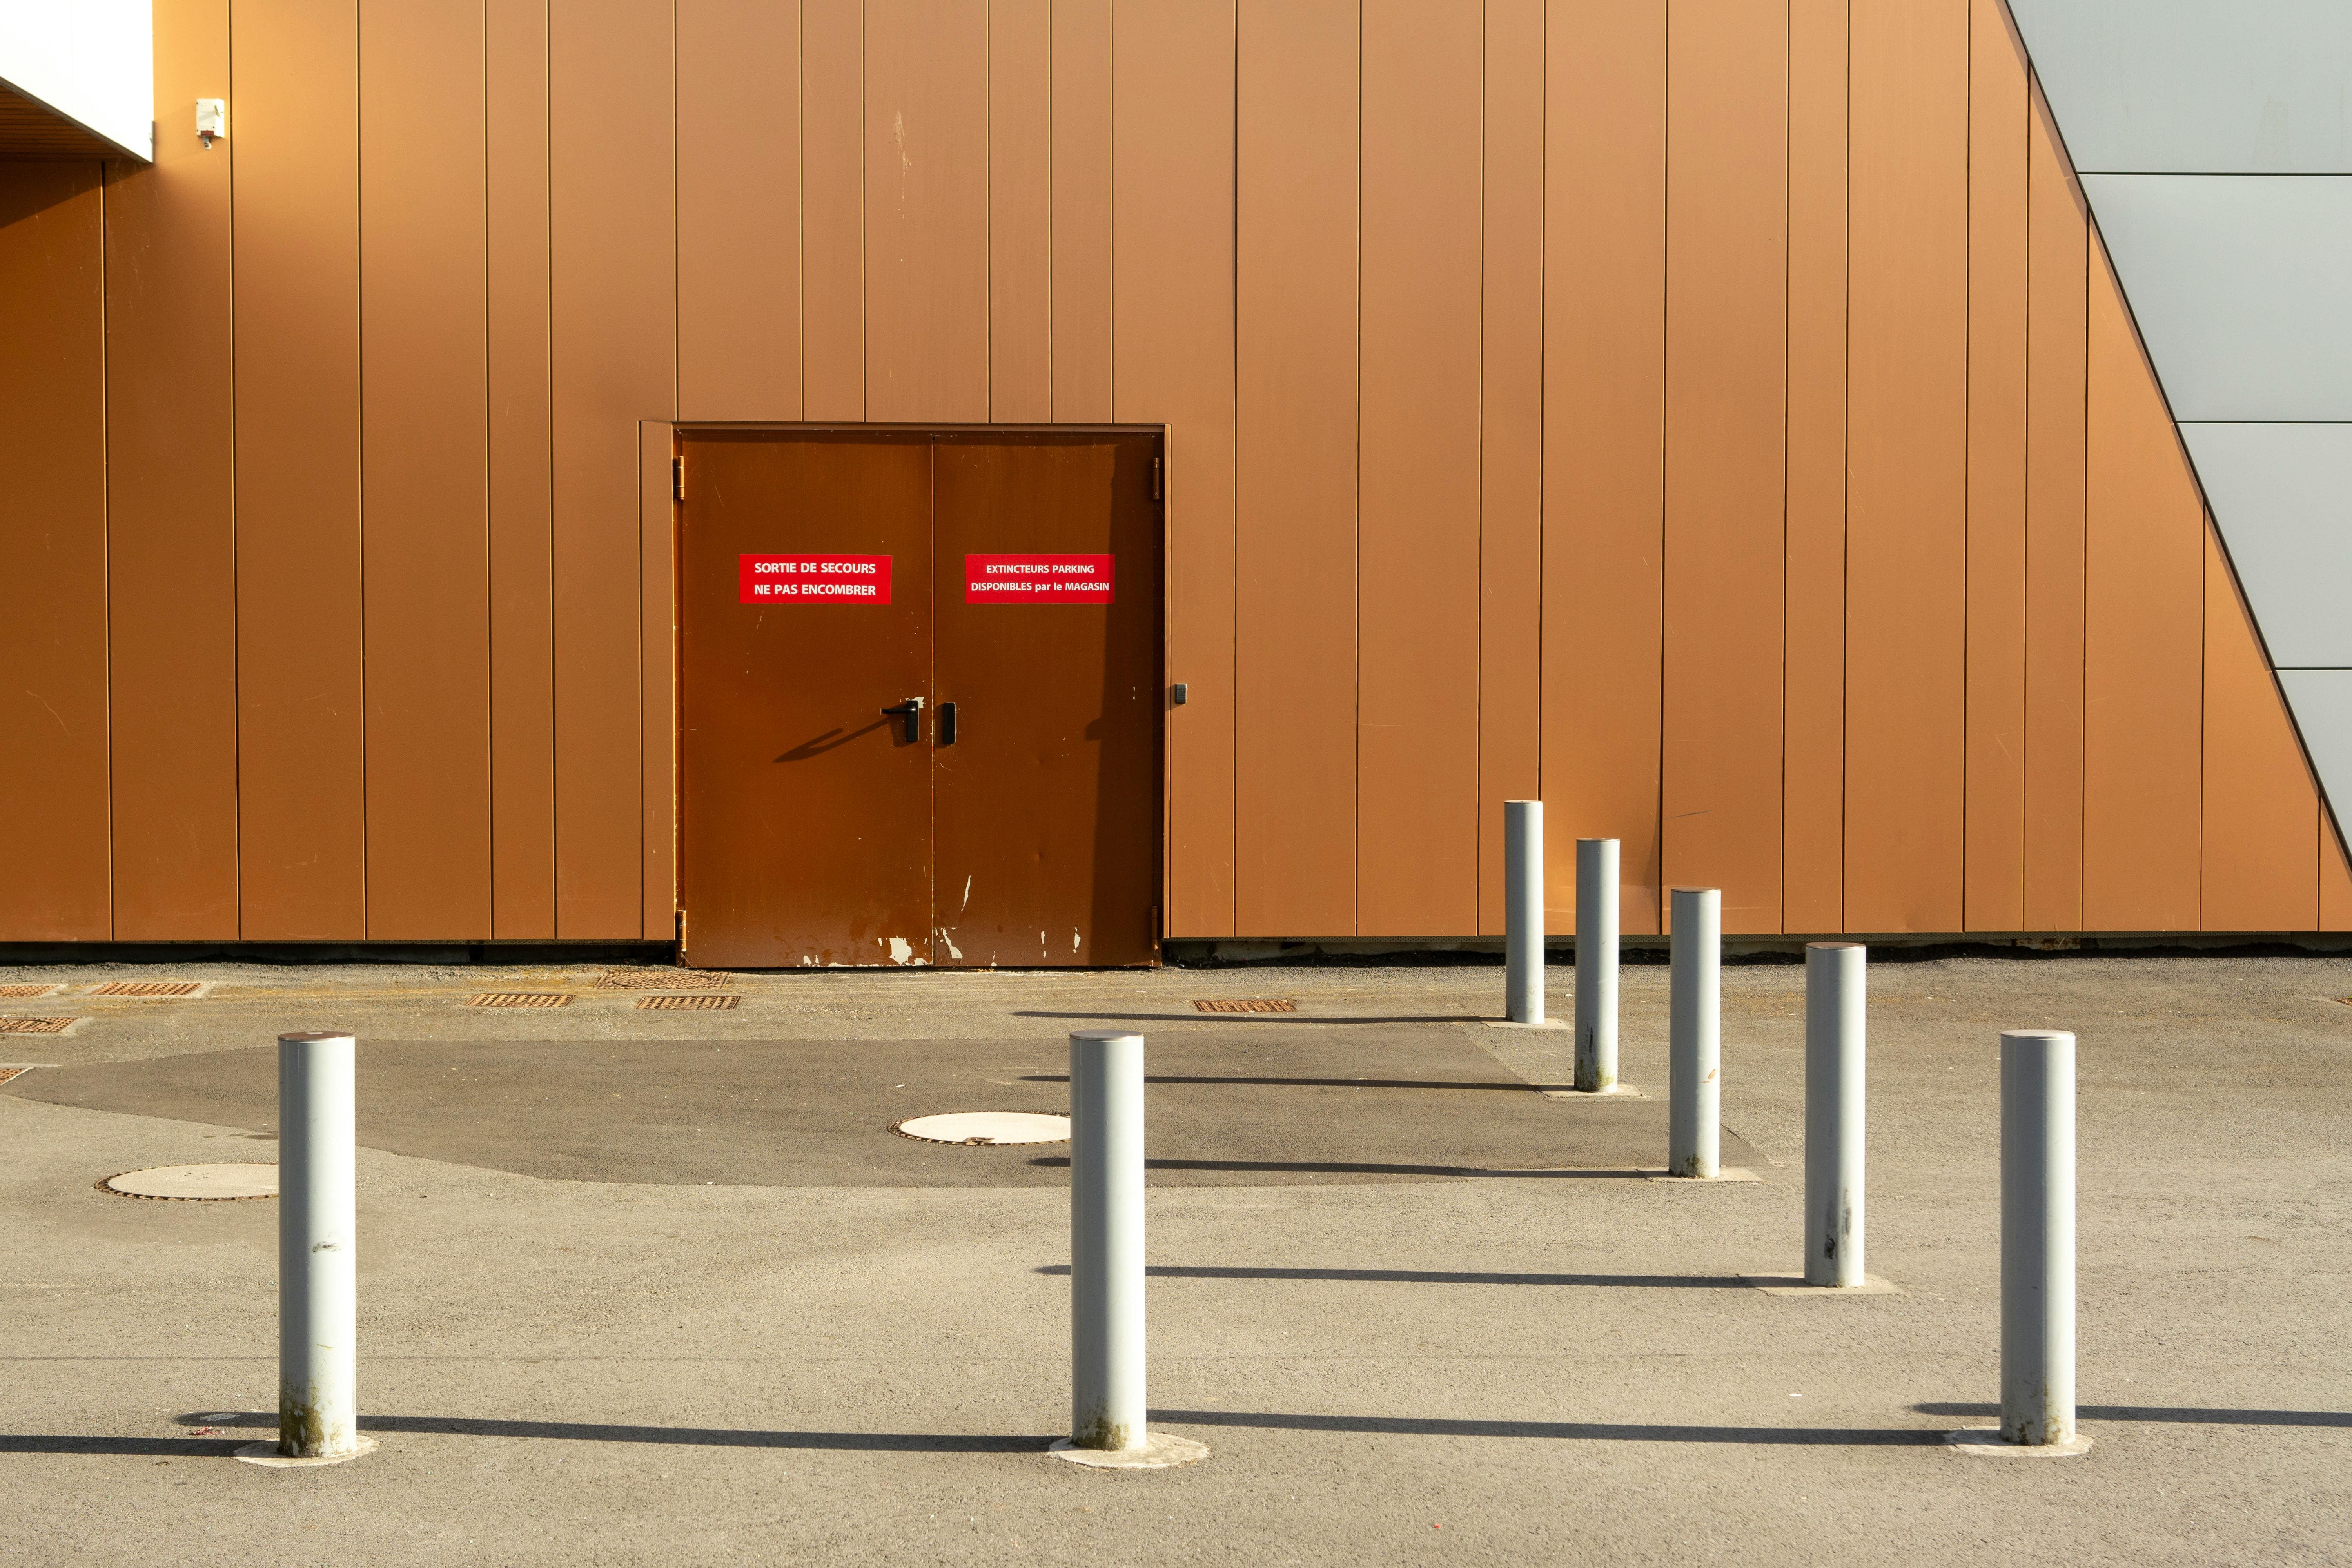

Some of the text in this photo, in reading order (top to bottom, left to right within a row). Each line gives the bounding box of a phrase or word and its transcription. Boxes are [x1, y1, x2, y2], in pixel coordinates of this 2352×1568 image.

[755, 563, 876, 574] SORTIE DE SECOURS
[986, 565, 1094, 573] EXTINCTEURS PARKING
[755, 584, 876, 595] NE PAS ENCOMBRER
[971, 582, 1110, 592] DISPONIBLES par le MAGASIN
